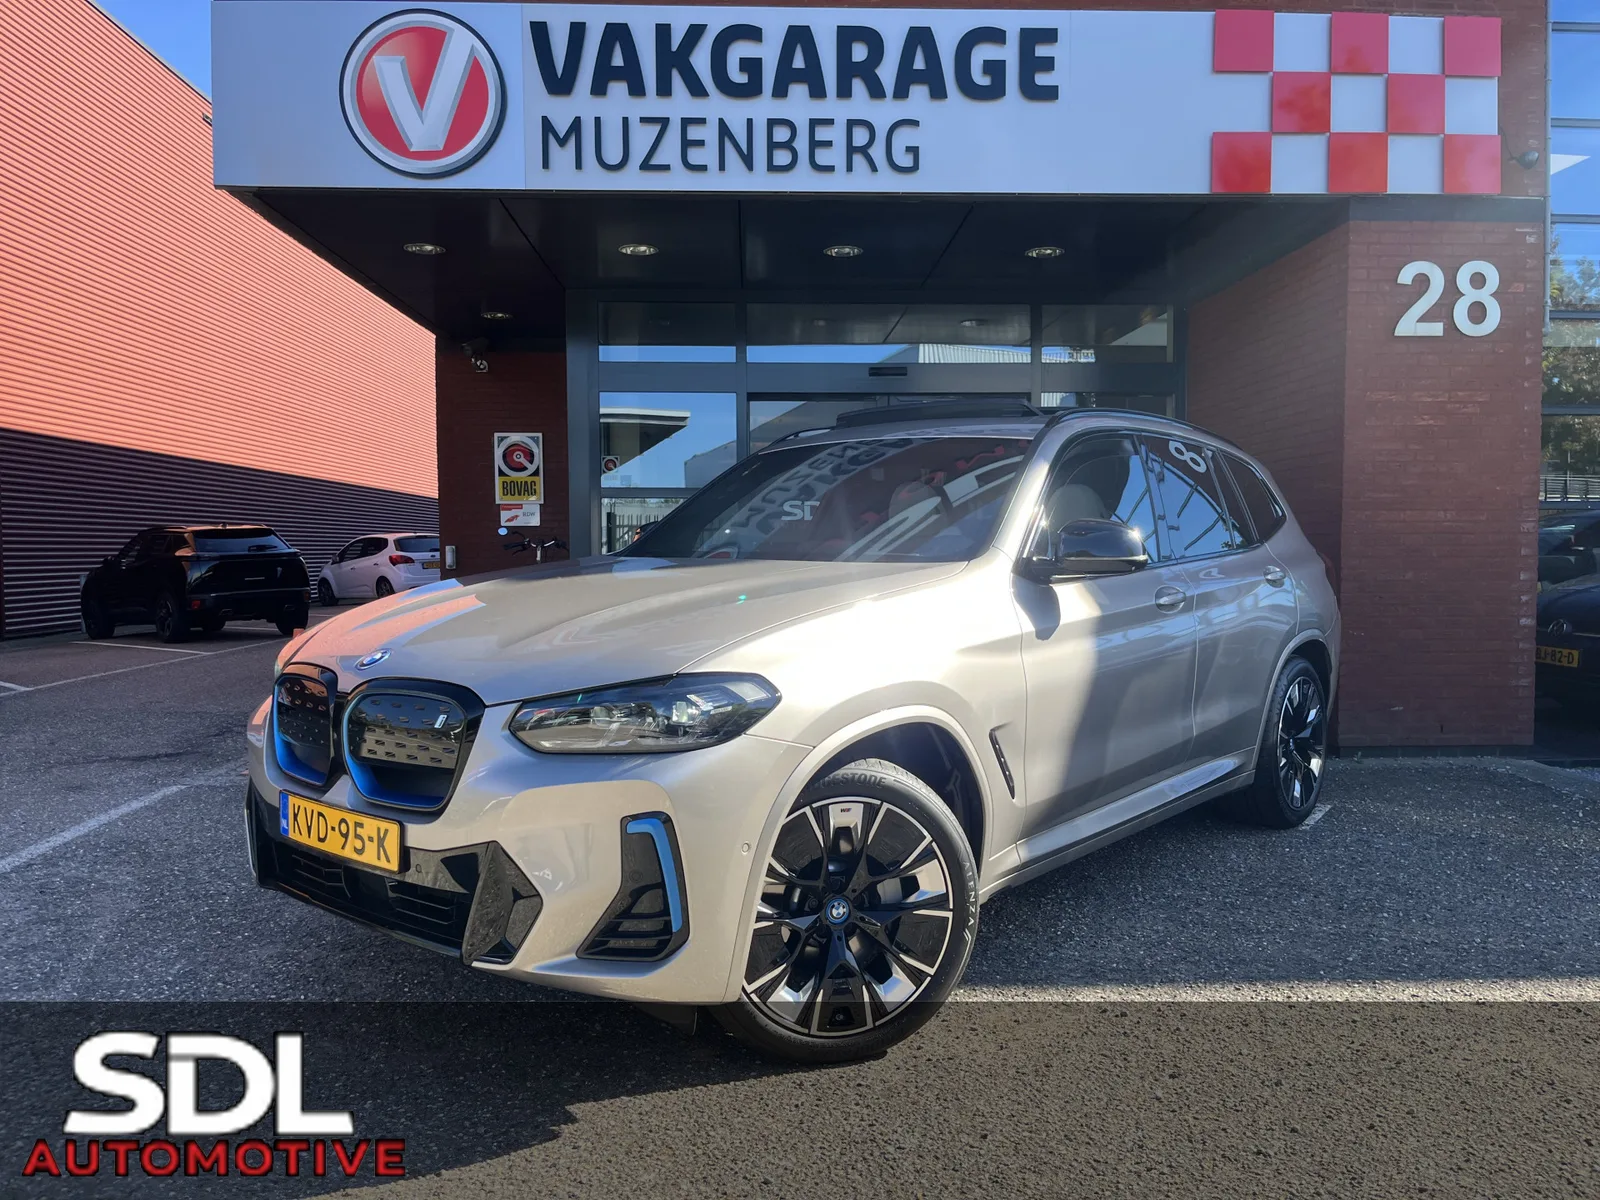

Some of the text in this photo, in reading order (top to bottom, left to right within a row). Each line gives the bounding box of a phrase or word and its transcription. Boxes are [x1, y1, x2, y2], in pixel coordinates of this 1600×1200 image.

[373, 24, 476, 152] V
[529, 21, 1059, 101] VAKGARAGE
[541, 115, 920, 173] MUZENBERG
[1393, 260, 1502, 338] 28
[502, 480, 537, 497] BOVAG
[281, 817, 289, 830] NL
[292, 802, 392, 865] KVD-95-K
[962, 861, 976, 927] ALENZA
